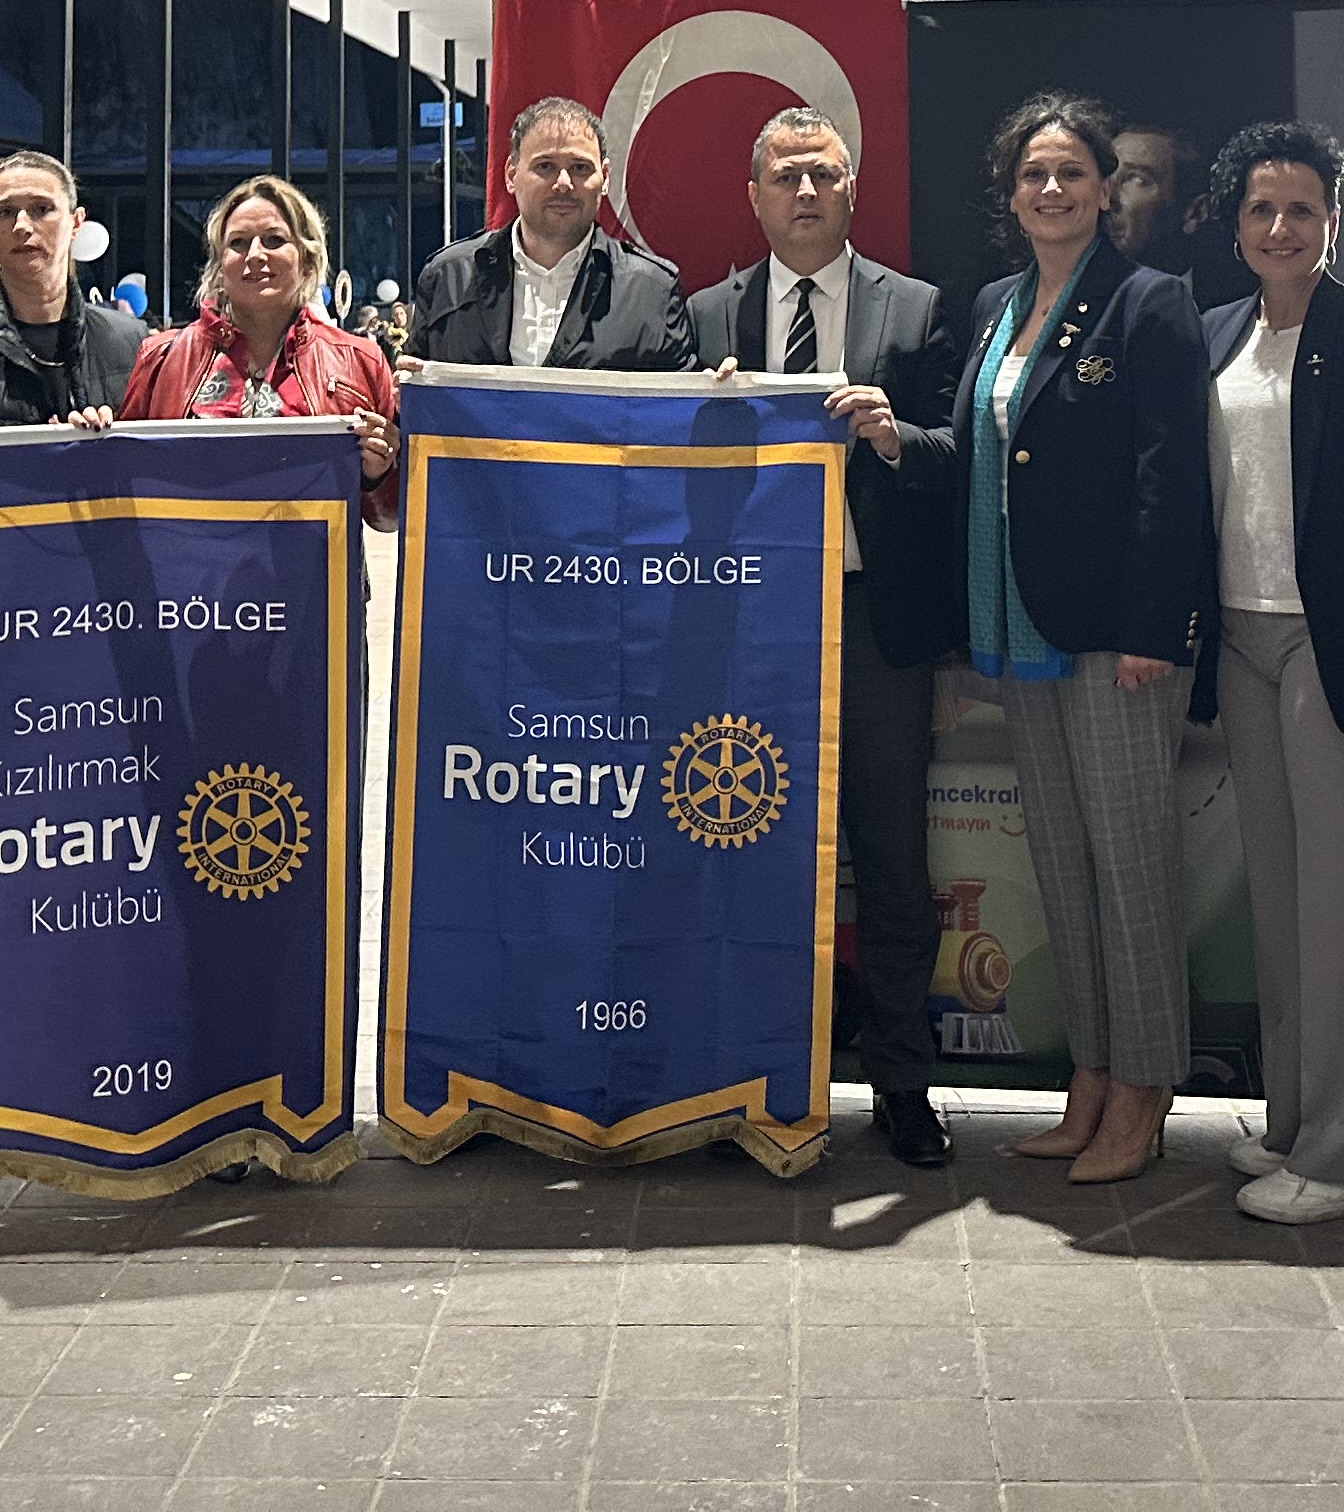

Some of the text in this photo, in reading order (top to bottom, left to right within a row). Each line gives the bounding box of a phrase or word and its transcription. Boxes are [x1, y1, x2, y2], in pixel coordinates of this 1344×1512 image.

[487, 552, 761, 584] UR 2430. BÖLGE
[53, 601, 142, 636] 2430.
[159, 596, 286, 630] BÖLGE
[15, 697, 161, 735] Samsun
[509, 704, 648, 740] Samsun
[701, 728, 753, 744] ROTARY
[216, 777, 273, 795] ROTARY
[444, 745, 644, 818] Rotary
[680, 803, 769, 834] INTERNATIONAL
[523, 832, 644, 869] Kulübü
[197, 852, 291, 886] INTERNATIONAL
[33, 887, 160, 933] Kulübü
[576, 1000, 646, 1030] 1966
[93, 1060, 171, 1096] 2019
